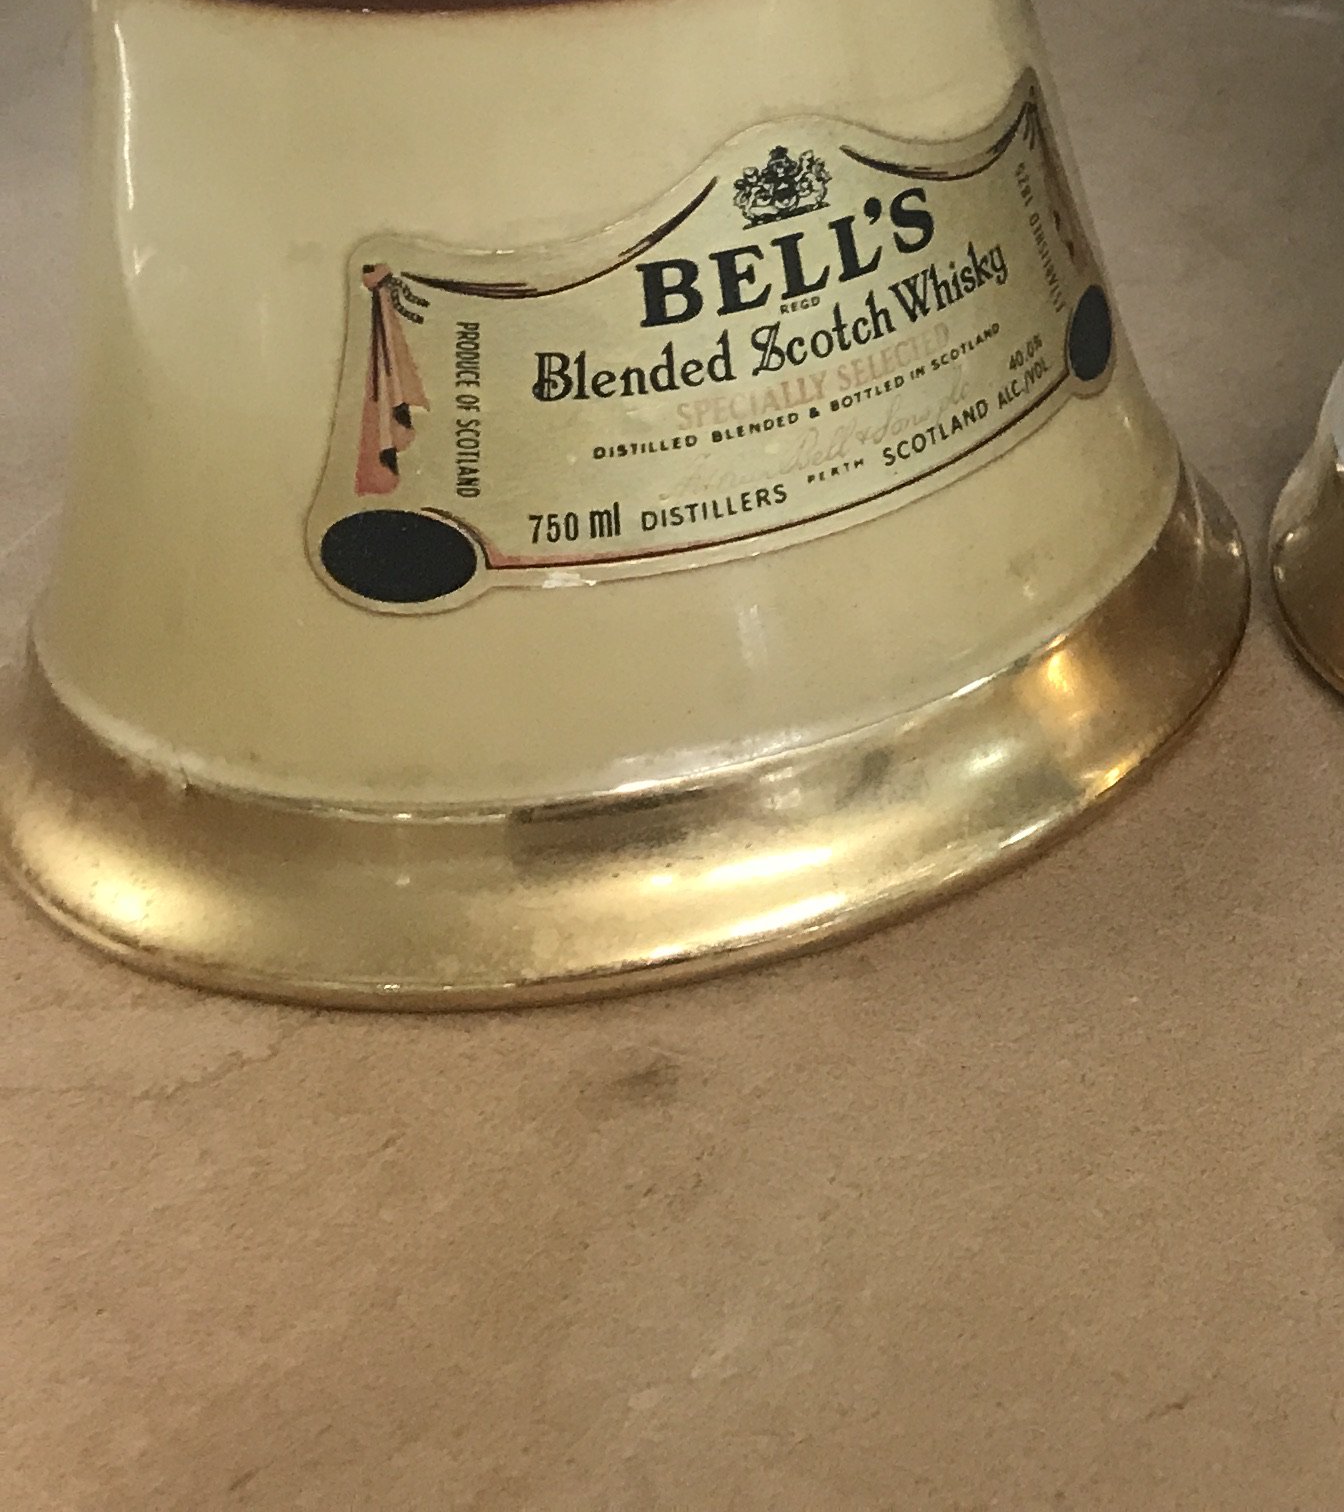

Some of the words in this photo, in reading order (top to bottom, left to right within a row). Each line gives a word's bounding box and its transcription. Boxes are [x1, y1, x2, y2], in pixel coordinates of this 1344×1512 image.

[635, 187, 935, 328] BELL'S
[455, 320, 481, 388] PRODUCE
[531, 328, 737, 403] Blended
[750, 289, 897, 376] Scotch
[888, 240, 1009, 324] Whisky
[676, 369, 828, 431] SPECIALLY
[836, 321, 951, 392] SELECTED
[456, 393, 480, 413] OF
[592, 434, 698, 460] DISTILLED
[711, 412, 799, 444] BLENDED
[808, 406, 821, 419] &
[830, 374, 906, 412] BOTTLED
[910, 364, 926, 380] IN
[930, 322, 1000, 370] SCOTLAND
[456, 418, 481, 499] SCOTLAND
[528, 511, 580, 545] 750
[589, 501, 622, 540] ml
[640, 483, 788, 532] DISTILLERS
[807, 458, 865, 484] PERTH
[882, 398, 989, 467] SCOTLAND
